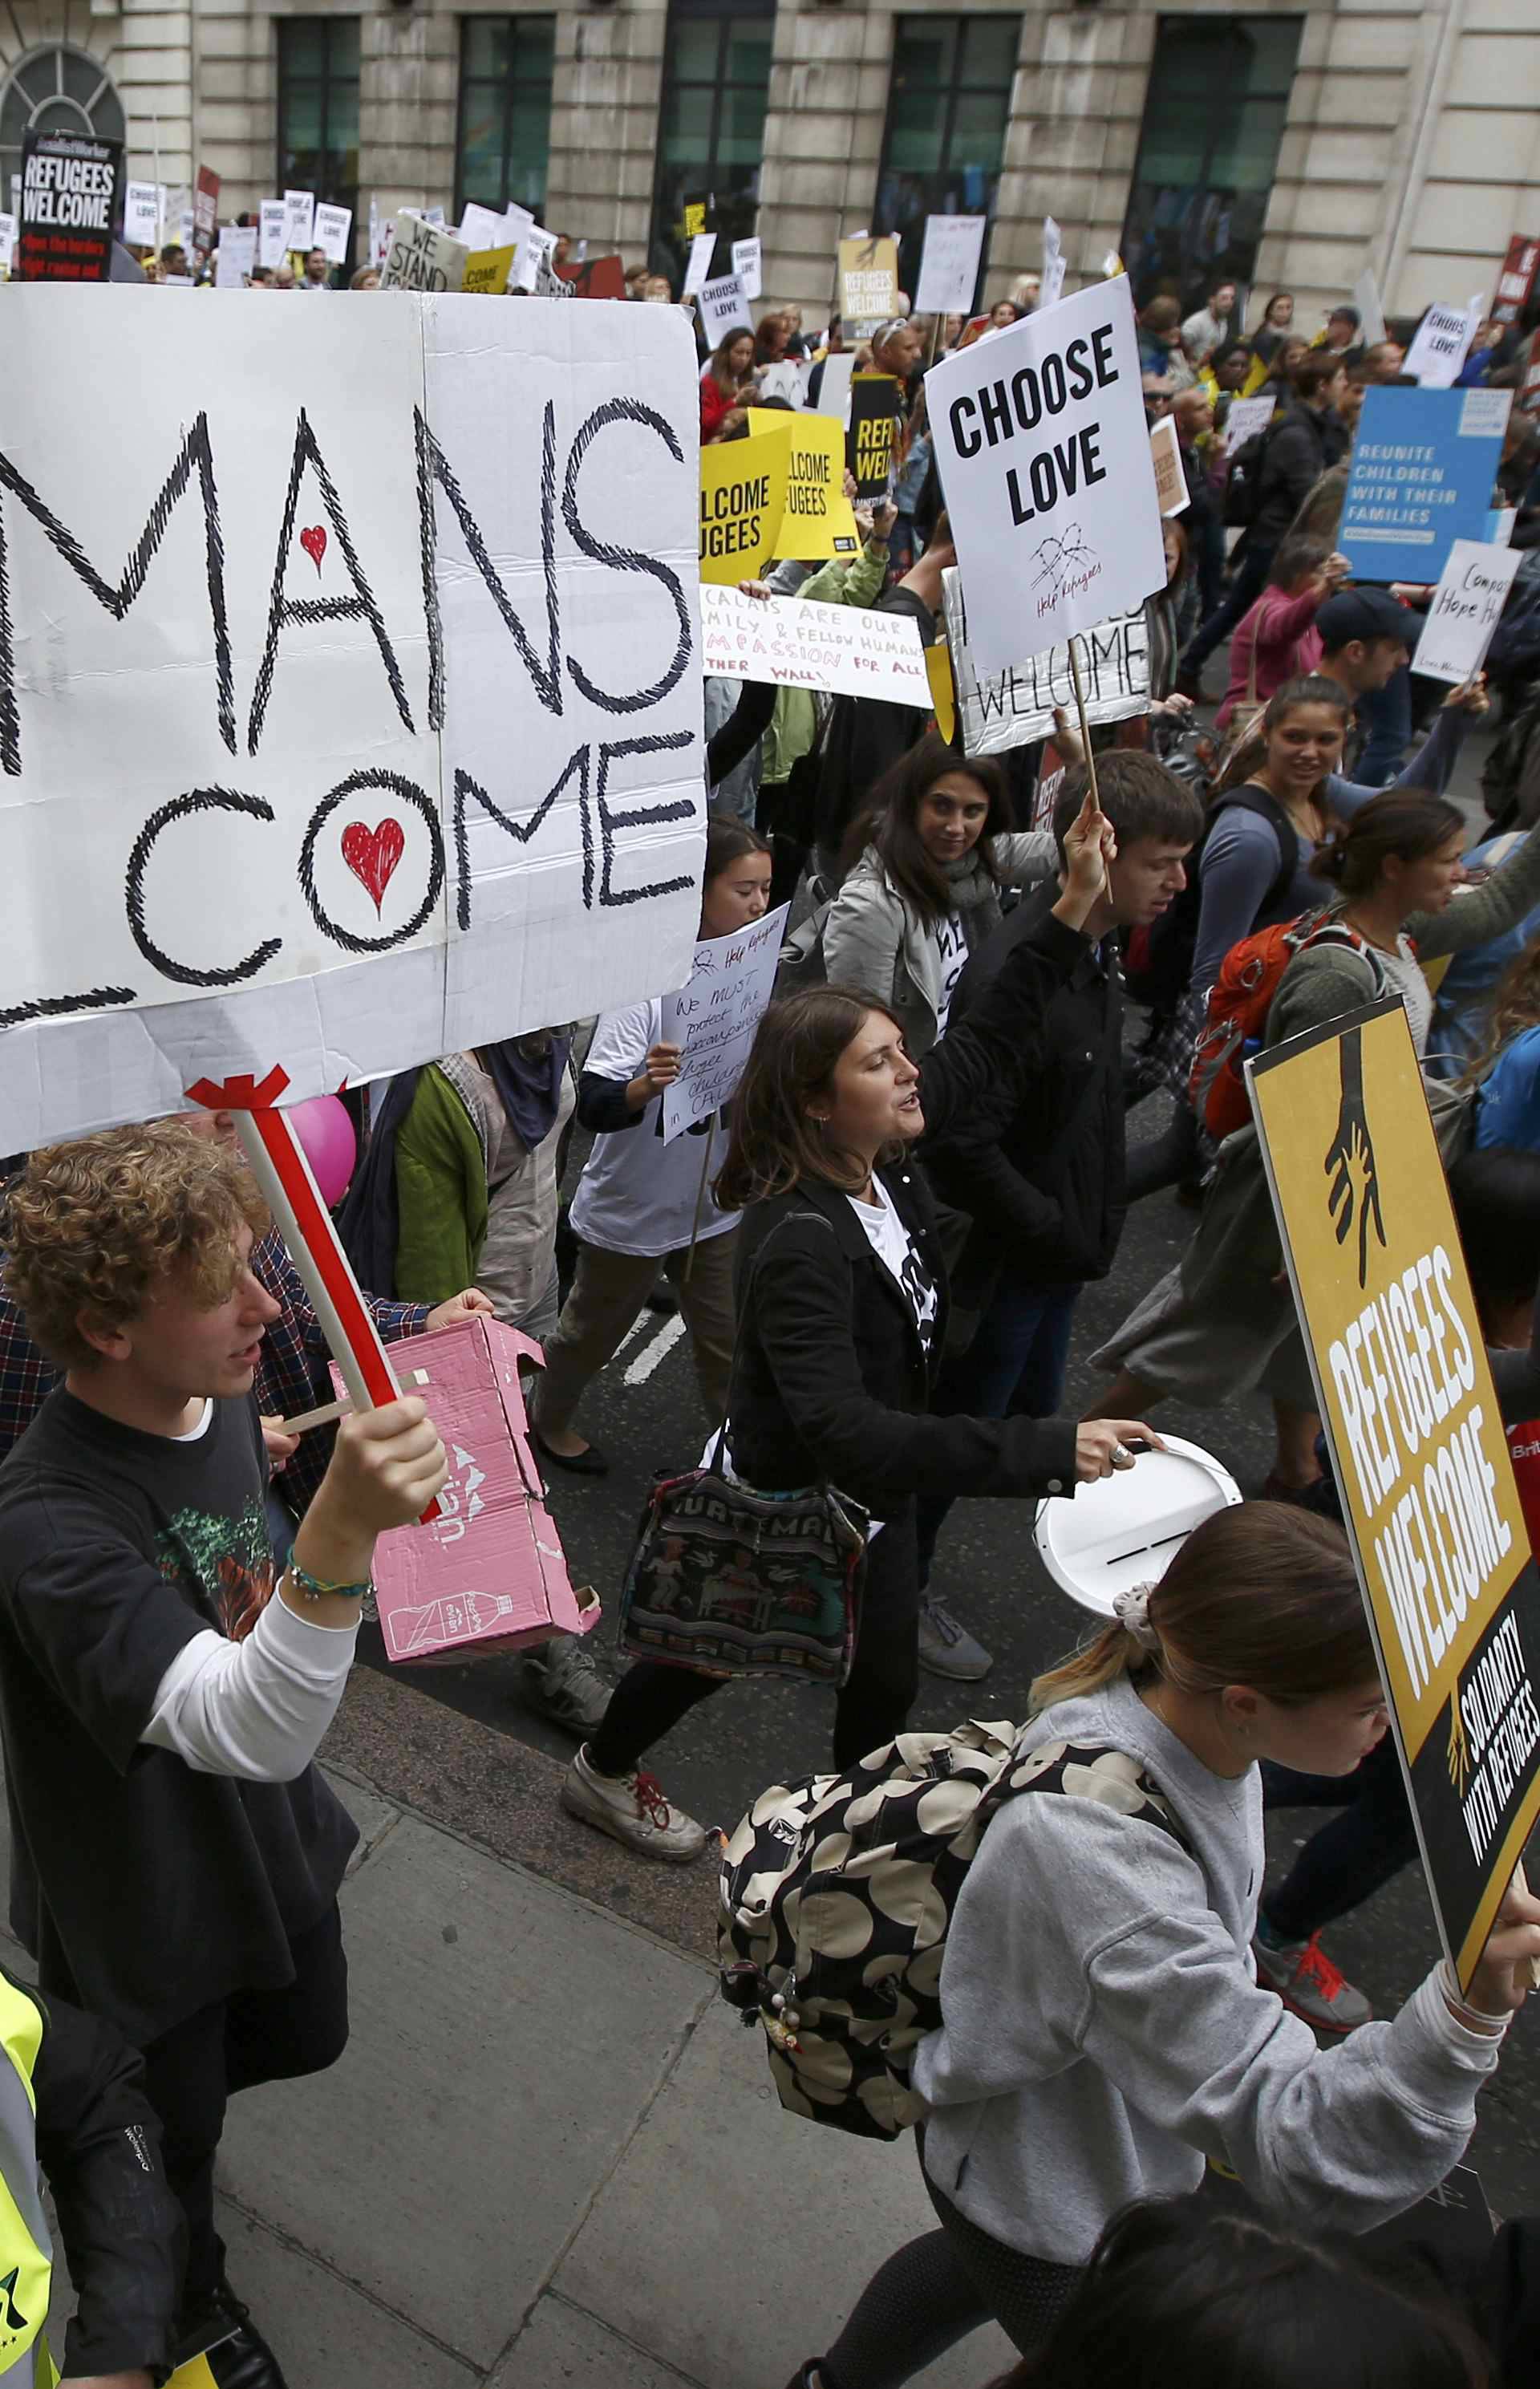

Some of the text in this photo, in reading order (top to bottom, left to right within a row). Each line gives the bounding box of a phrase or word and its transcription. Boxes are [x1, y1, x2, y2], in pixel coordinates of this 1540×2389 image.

[25, 155, 115, 196] REFUGEES
[23, 189, 111, 230] WELCOME
[413, 222, 438, 257] WE
[391, 242, 448, 291] STAND
[463, 266, 500, 285] COME
[703, 281, 740, 302] CHOOSE
[847, 294, 893, 314] WELCOME
[715, 301, 739, 318] LOVE
[950, 322, 1119, 459] CHOOSE
[1358, 444, 1436, 462] REUNITE
[1006, 422, 1107, 527] LOVE
[1354, 464, 1445, 483] CHILDREN
[784, 484, 827, 516] UGEES
[1351, 485, 1457, 505] WITH THEIR
[1348, 505, 1431, 524] FAMILIES
[0, 397, 692, 775] MANS
[705, 588, 901, 635] CALAIS ARE OUR
[1436, 590, 1477, 619] Hope
[776, 622, 788, 639] &
[796, 627, 853, 646] FELLOW
[703, 656, 749, 672] THER
[853, 656, 881, 672] FOR
[971, 622, 1148, 724] WELCOME
[711, 968, 760, 1006] MUST
[1328, 1244, 1475, 1519] REFUGEES
[1374, 1404, 1513, 1702] WELCOME
[445, 1604, 459, 1634] evian
[1461, 1608, 1526, 1764] SOLIDARITY
[1462, 1679, 1540, 1868] WITH REFUGEES
